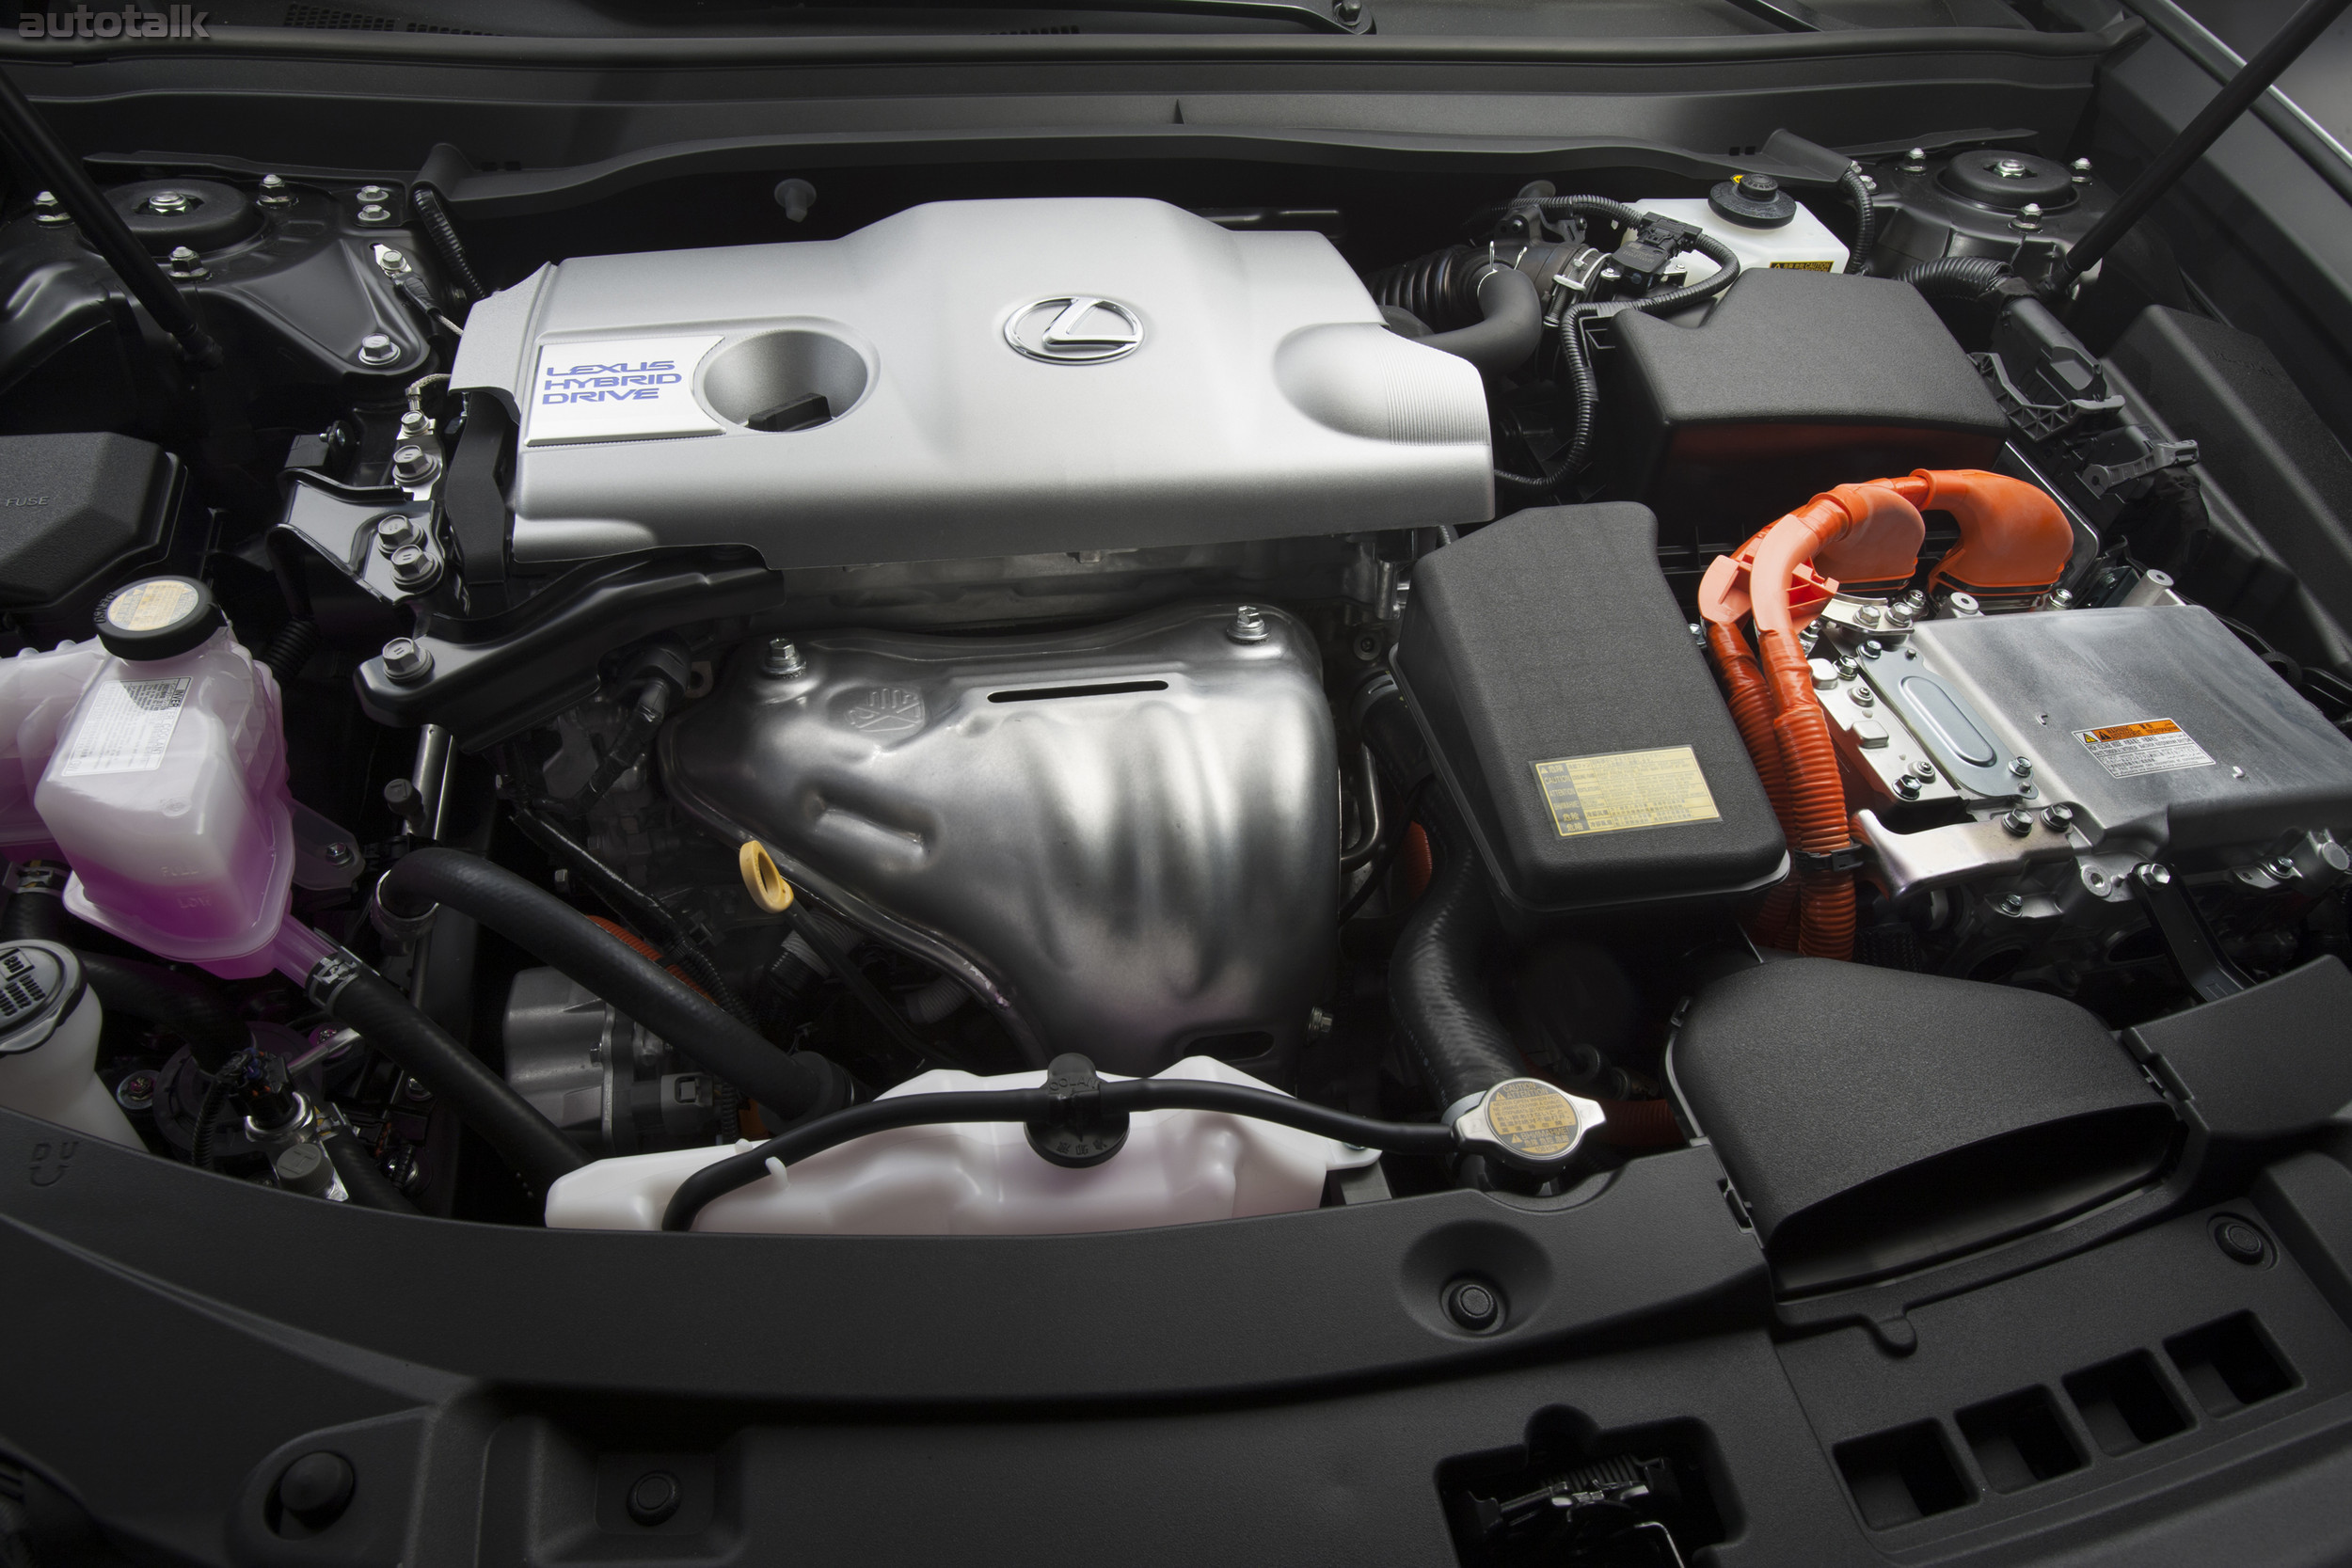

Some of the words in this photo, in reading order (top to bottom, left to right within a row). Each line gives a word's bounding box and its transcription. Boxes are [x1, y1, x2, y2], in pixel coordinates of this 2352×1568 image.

[547, 360, 675, 376] LEXUS
[544, 373, 682, 390] HYBRID
[542, 388, 660, 404] DRIVE
[6, 496, 50, 507] FUSE
[94, 593, 117, 624] DENSO
[1544, 775, 1571, 784] CAUTION
[1502, 1082, 1536, 1092] CAUTION
[1505, 1087, 1549, 1100] ATTENTION
